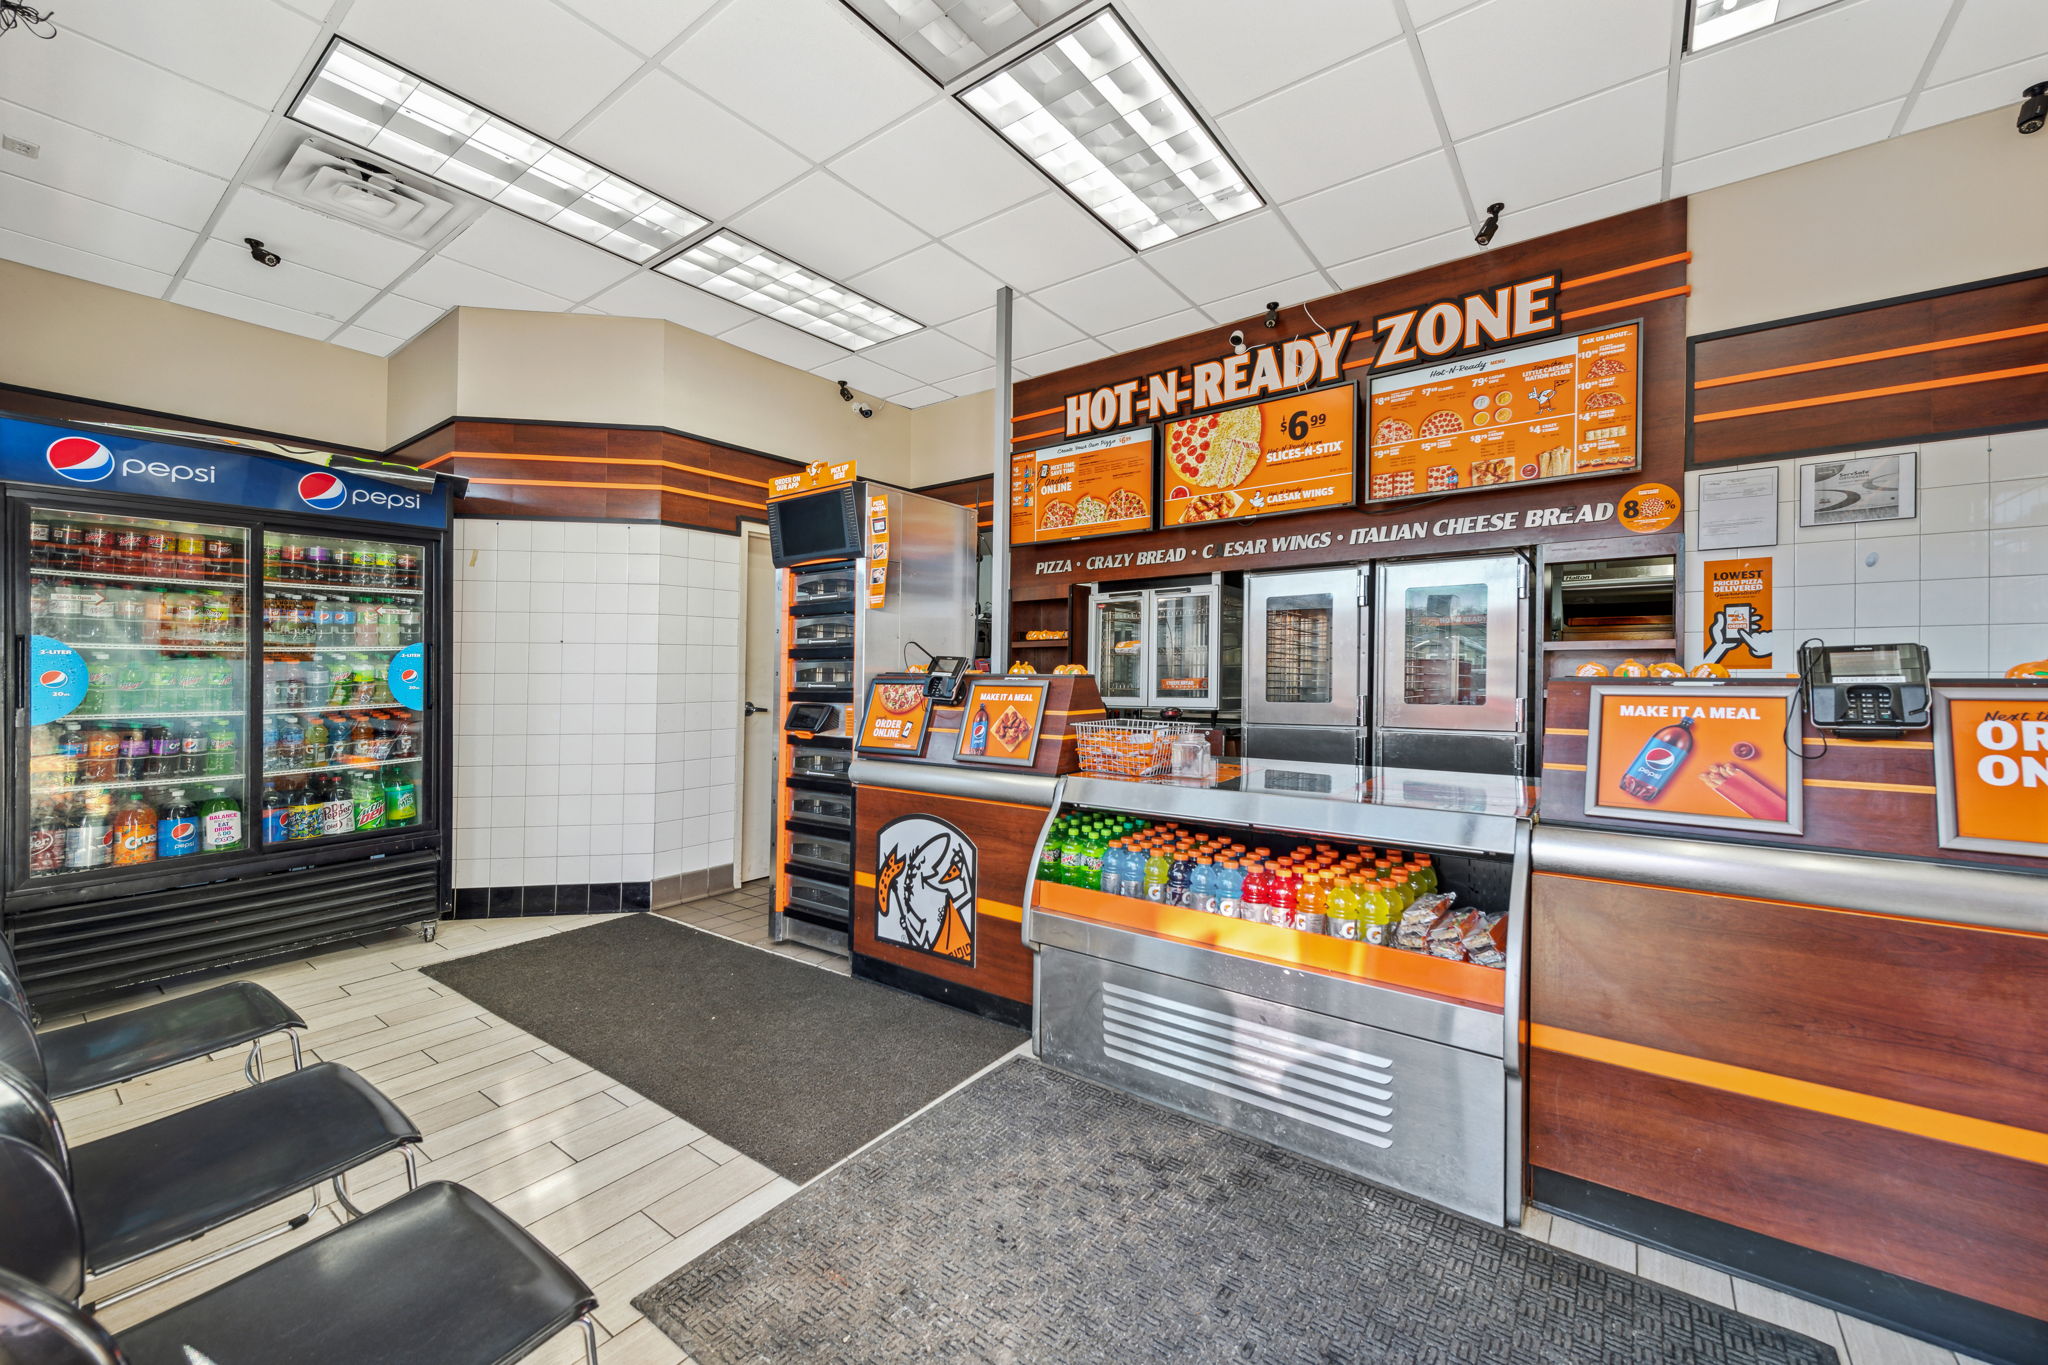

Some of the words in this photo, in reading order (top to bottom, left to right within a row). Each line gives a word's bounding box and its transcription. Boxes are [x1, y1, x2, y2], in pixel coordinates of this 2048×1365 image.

[1064, 322, 1355, 438] HOT-N-READY
[1374, 274, 1555, 368] ZONE
[1429, 361, 1487, 378] Hot-N-Ready
[1522, 368, 1542, 377] LITTLE
[1543, 362, 1574, 374] CAESARS
[1524, 373, 1549, 382] NATION
[1265, 440, 1343, 463] SLICES-N-STIX
[122, 457, 216, 484] pepsi
[830, 466, 841, 474] PICK
[841, 463, 849, 471] UP
[833, 471, 845, 480] HERE
[774, 477, 792, 486] ORDER
[776, 483, 788, 491] OUR
[1040, 482, 1072, 495] ONLINE
[352, 488, 420, 509] pepsi
[1266, 491, 1301, 503] CAESAR
[1302, 486, 1334, 499] WINGS
[1036, 559, 1073, 575] PIZZA
[1086, 552, 1134, 570] CRAZY
[1136, 547, 1187, 566] BREAD
[1272, 531, 1332, 551] WINGS
[1349, 522, 1428, 545] ITALIAN
[1432, 511, 1519, 537] CHEESE
[1524, 502, 1615, 528] BREAD
[1713, 569, 1764, 580] LOWEST
[1713, 584, 1764, 592] DELIVERED
[979, 692, 1000, 700] MAKE
[1000, 693, 1008, 701] IT
[1013, 693, 1033, 701] MEAL
[1619, 704, 1669, 717] MAKE
[1672, 706, 1690, 717] IT
[1692, 707, 1706, 718] A
[1709, 707, 1761, 720] MEAL
[1984, 710, 2030, 722] Next
[875, 718, 903, 729] ORDER
[873, 727, 901, 738] ONLINE
[1638, 766, 1663, 780] pepsi
[209, 812, 238, 821] BALANCE
[325, 821, 339, 831] Diet
[173, 840, 195, 850] pepsi
